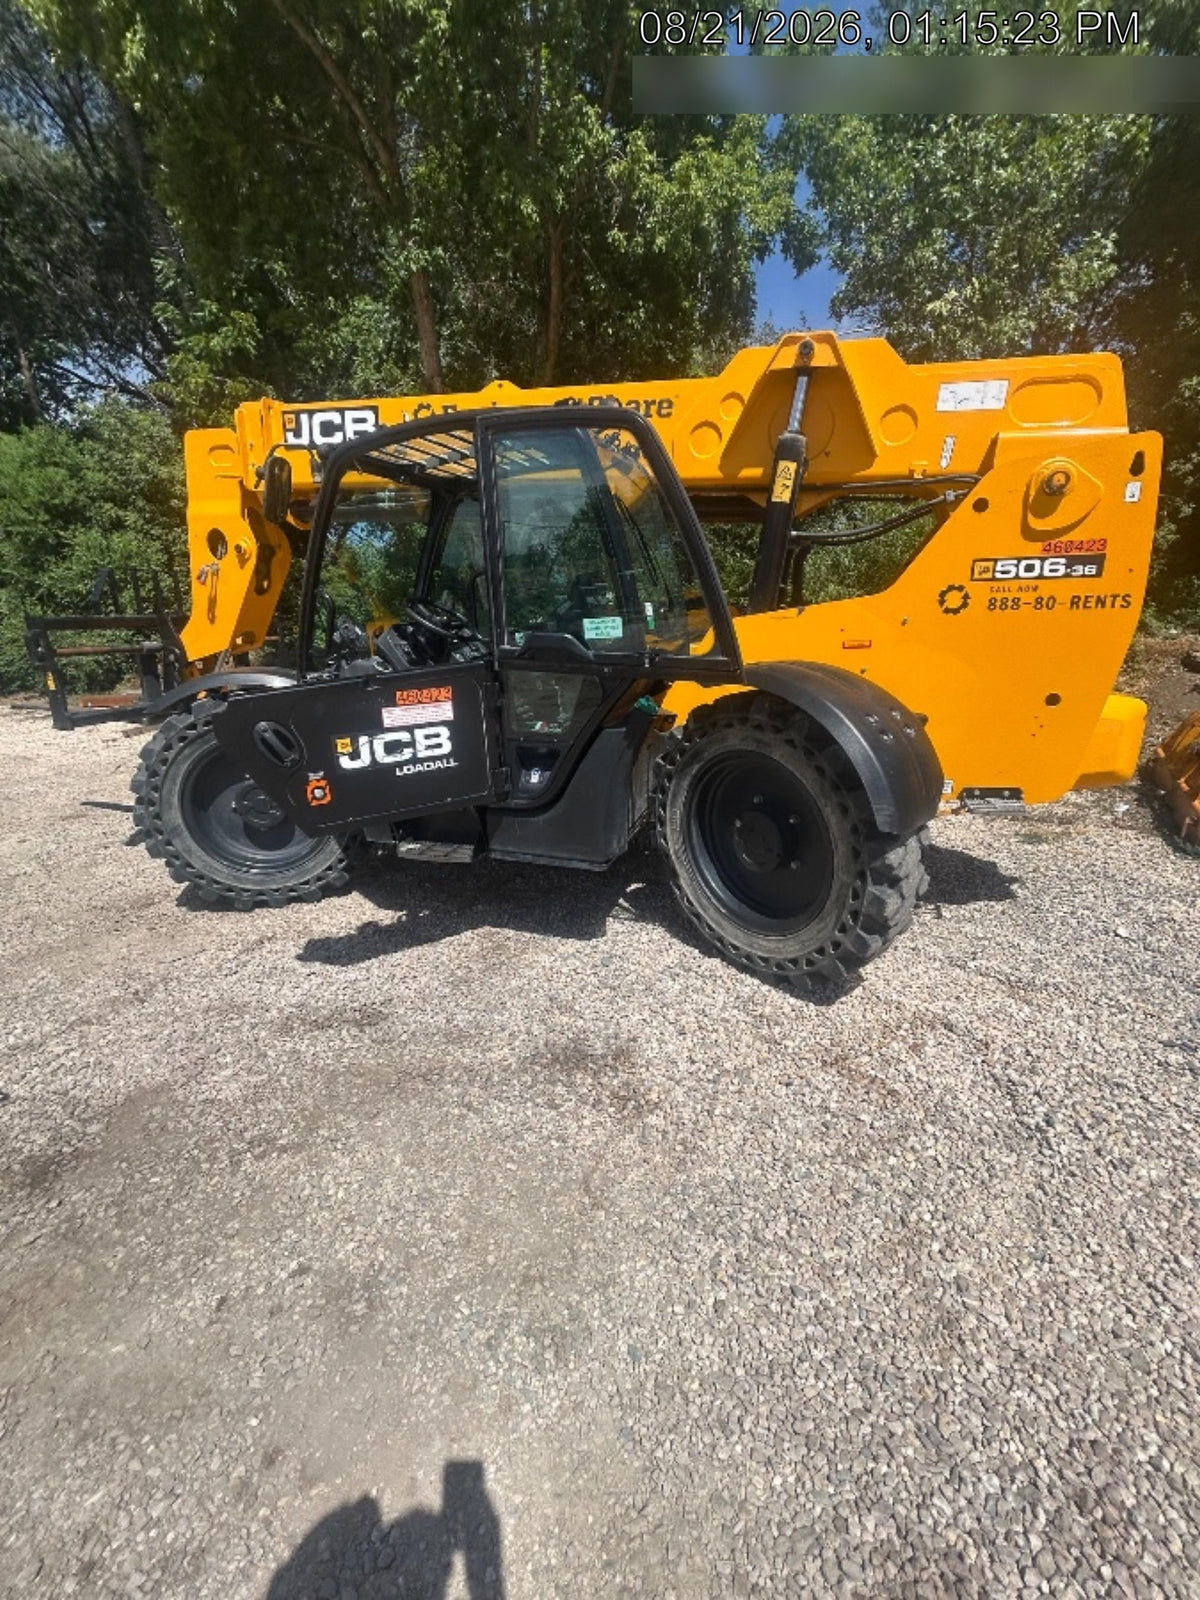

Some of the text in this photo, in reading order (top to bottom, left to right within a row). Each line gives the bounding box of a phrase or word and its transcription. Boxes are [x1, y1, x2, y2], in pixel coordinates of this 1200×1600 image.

[284, 409, 377, 446] JCB
[1042, 538, 1108, 554] 460423
[989, 584, 1040, 594] CALL NOW
[337, 726, 453, 770] JCB
[395, 758, 460, 777] LOADALL
